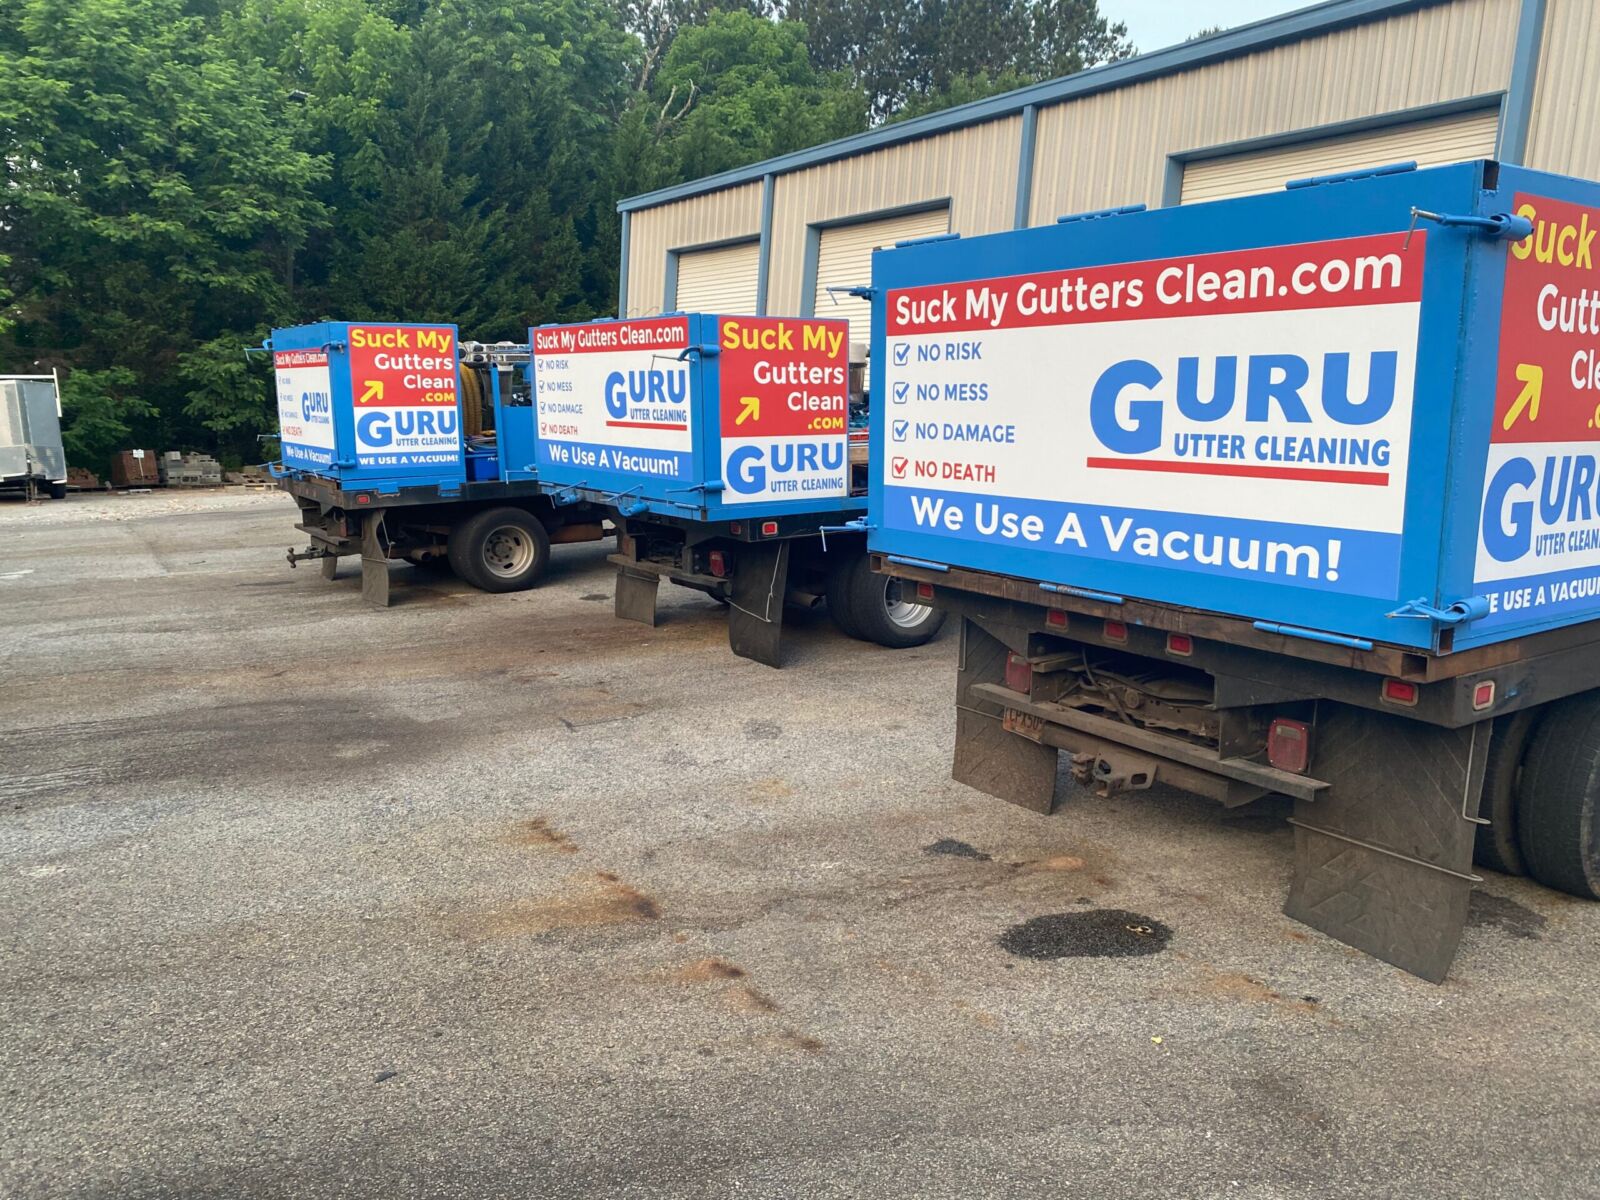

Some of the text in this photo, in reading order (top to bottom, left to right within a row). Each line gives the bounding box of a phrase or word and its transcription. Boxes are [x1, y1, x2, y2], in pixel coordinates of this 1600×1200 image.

[1511, 204, 1597, 269] Suck
[895, 253, 1402, 327] Suck My Gutters Clean.com
[352, 329, 451, 353] Suck My
[537, 325, 684, 352] Suck My Gutters Clean.com
[723, 321, 844, 358] Suck My
[374, 353, 453, 370] Gutters
[917, 342, 982, 362] NO RISK
[546, 360, 569, 369] NO RISK
[753, 361, 844, 384] Gutters
[403, 375, 454, 389] Clean
[547, 382, 573, 392] NO MESS
[917, 383, 988, 401] NO MESS
[604, 370, 686, 419] GURU
[787, 391, 843, 411] Clean
[1089, 350, 1399, 455] GURU
[302, 392, 329, 422] GURU
[548, 404, 583, 414] NO DAMAGE
[630, 408, 687, 423] UTTER CLEANING
[357, 410, 456, 447] GURU
[549, 425, 578, 435] NO DEATH
[808, 417, 843, 429] .COM
[915, 423, 1016, 443] NO DAMAGE
[396, 437, 457, 446] UTTER CLEANING
[1173, 433, 1391, 466] UTTER CLEANING
[359, 454, 459, 465] WE USE A VACUUM!
[549, 444, 679, 476] We Use A Vacuum!
[726, 443, 844, 495] GURU
[914, 460, 996, 483] NO DEATH
[771, 477, 843, 492] UTTER CLEANING
[1482, 455, 1600, 562] GUR
[911, 495, 1342, 582] We Use A Vacuum!
[1536, 531, 1565, 557] UTTER
[1486, 593, 1499, 613] E
[1503, 587, 1532, 611] USE
[1535, 585, 1546, 606] A
